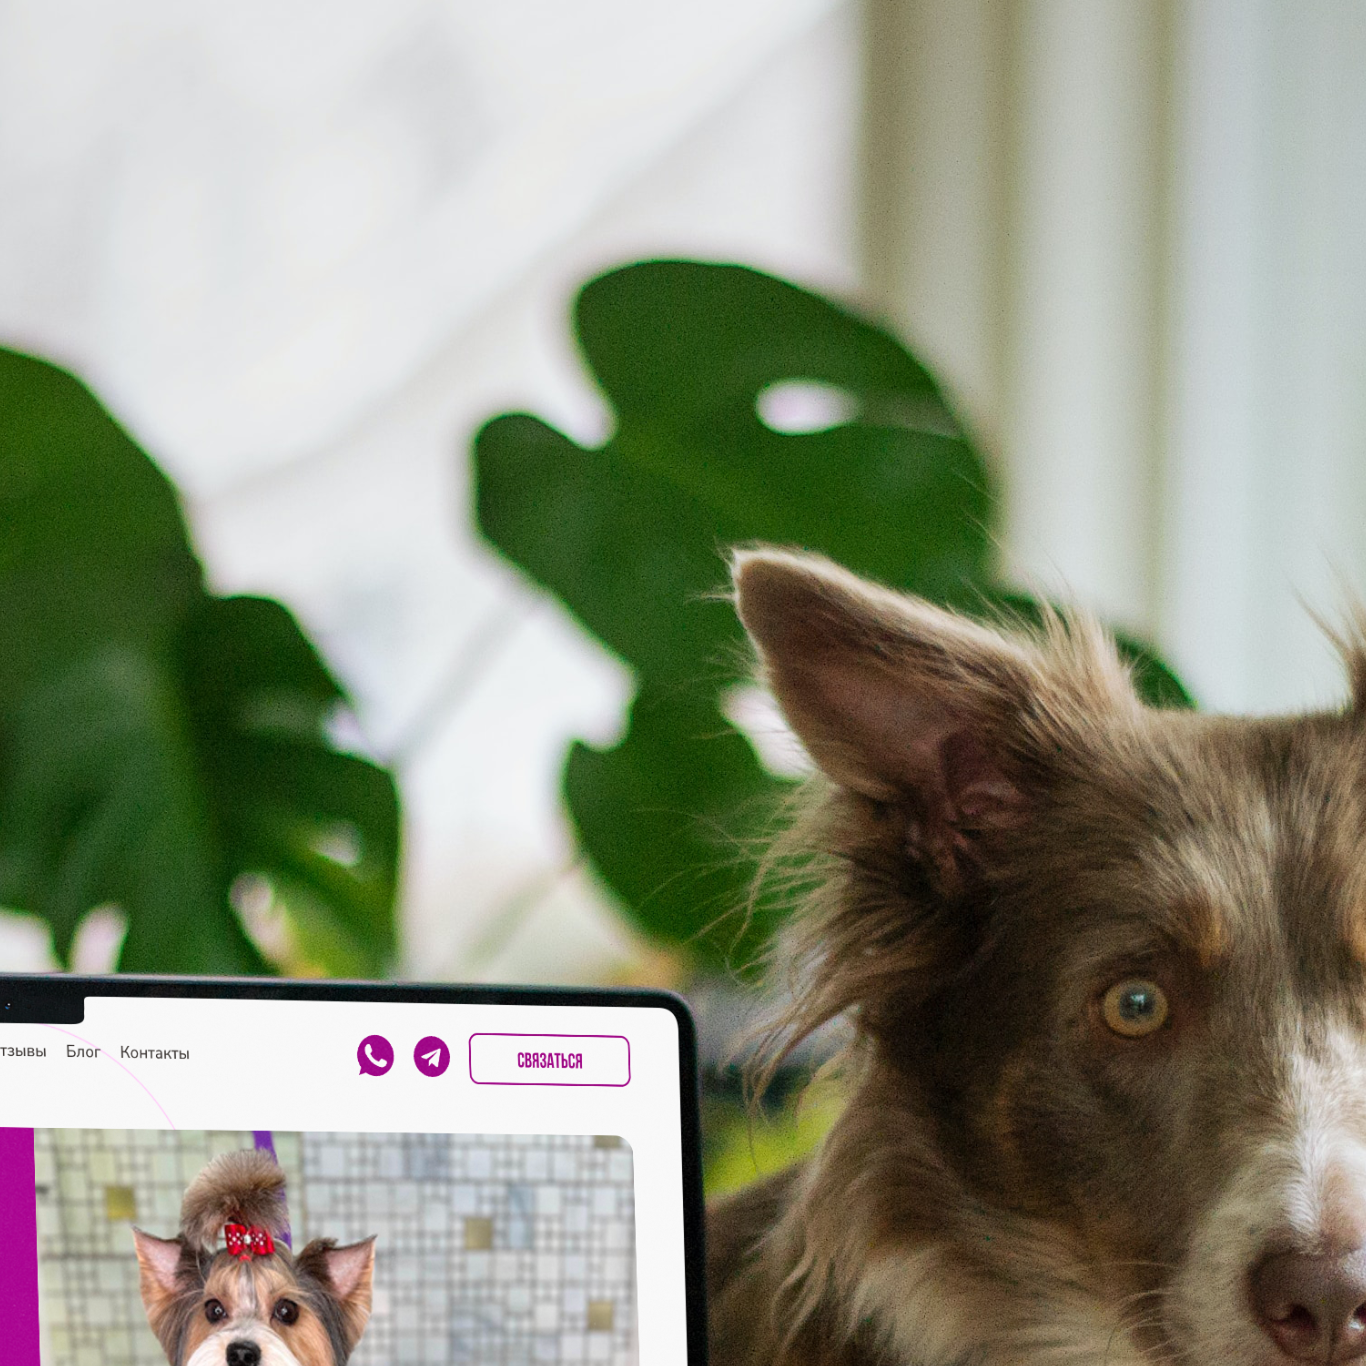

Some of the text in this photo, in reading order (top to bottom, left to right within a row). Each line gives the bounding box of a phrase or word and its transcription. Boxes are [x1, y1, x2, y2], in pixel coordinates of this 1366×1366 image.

[66, 1044, 101, 1058] Блог
[120, 1045, 190, 1060] Контакты
[517, 1051, 583, 1070] СВЯЗАТЬСЯ
